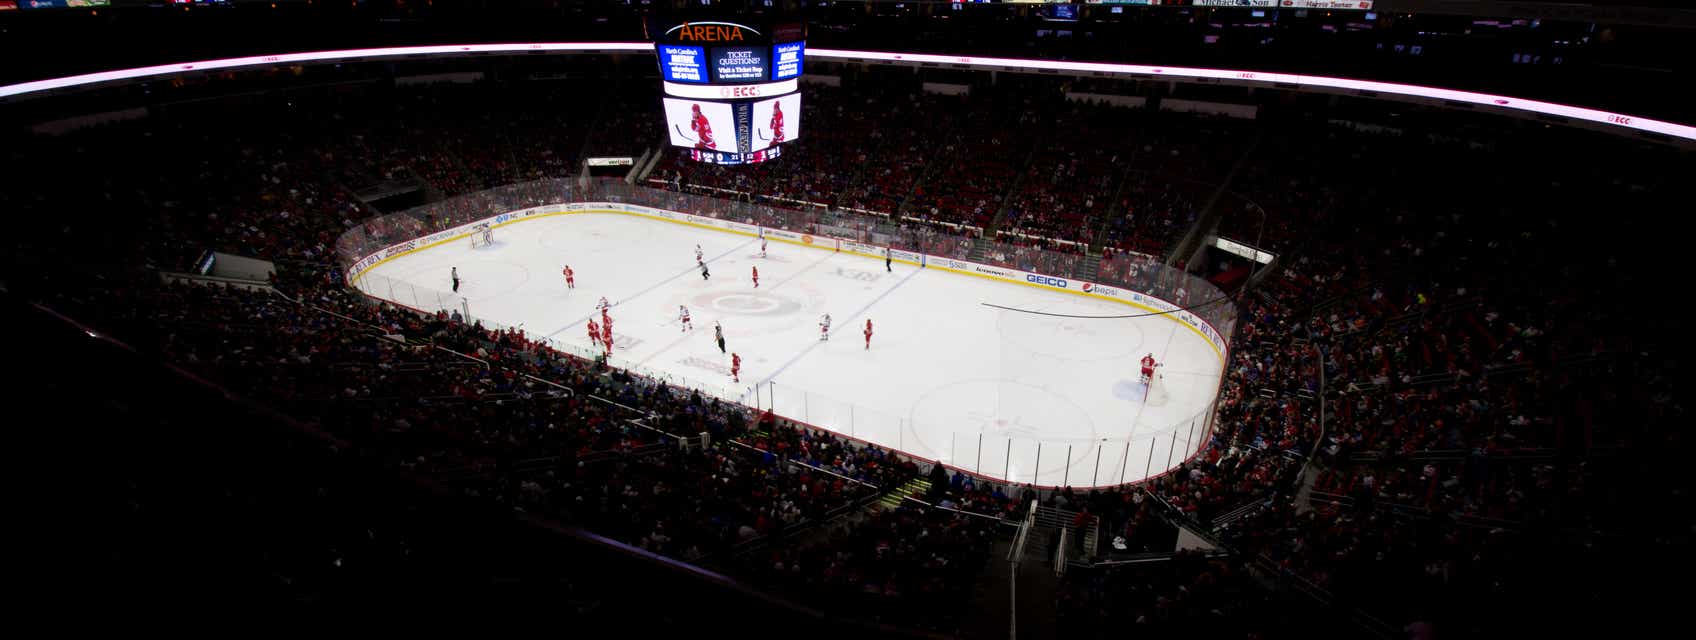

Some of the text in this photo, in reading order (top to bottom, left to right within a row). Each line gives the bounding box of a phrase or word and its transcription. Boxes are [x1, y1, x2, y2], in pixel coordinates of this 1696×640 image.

[679, 22, 744, 41] ARENA
[720, 57, 761, 65] QUESTIONS?
[1026, 274, 1067, 288] GEICO
[1094, 282, 1118, 296] pepsi
